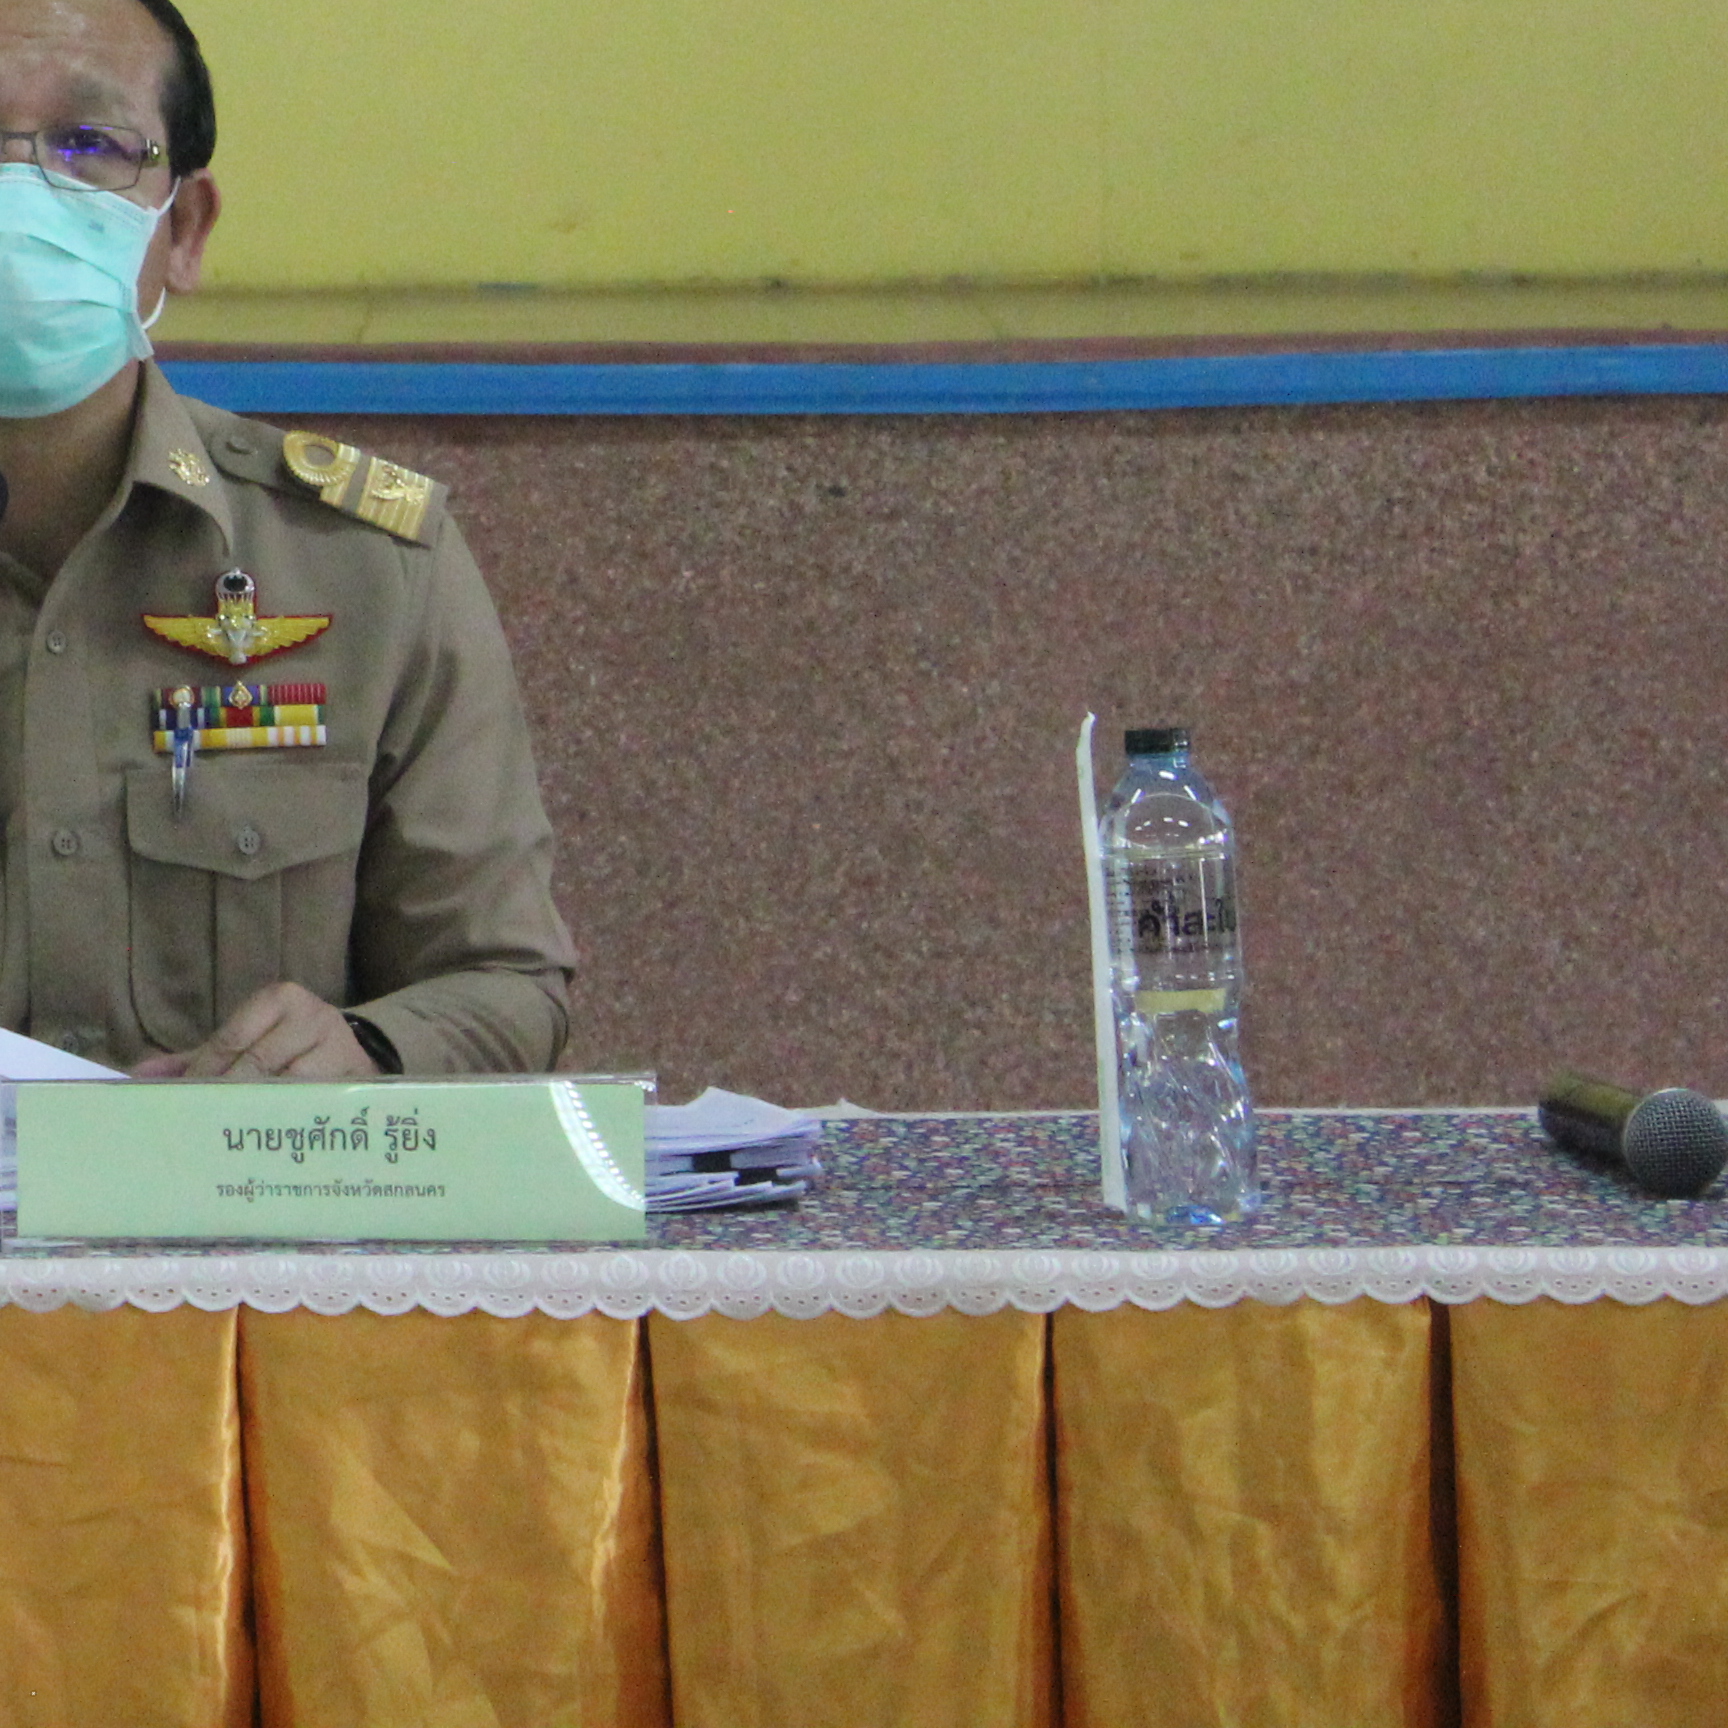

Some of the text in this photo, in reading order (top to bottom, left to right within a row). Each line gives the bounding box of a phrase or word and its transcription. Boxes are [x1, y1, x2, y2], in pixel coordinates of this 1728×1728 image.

[223, 1106, 436, 1164] นายชูศักดิ์ รู้ยิ่ง
[216, 1178, 446, 1203] รองผู้ว่าราชการจังหวัดสกลนคร
